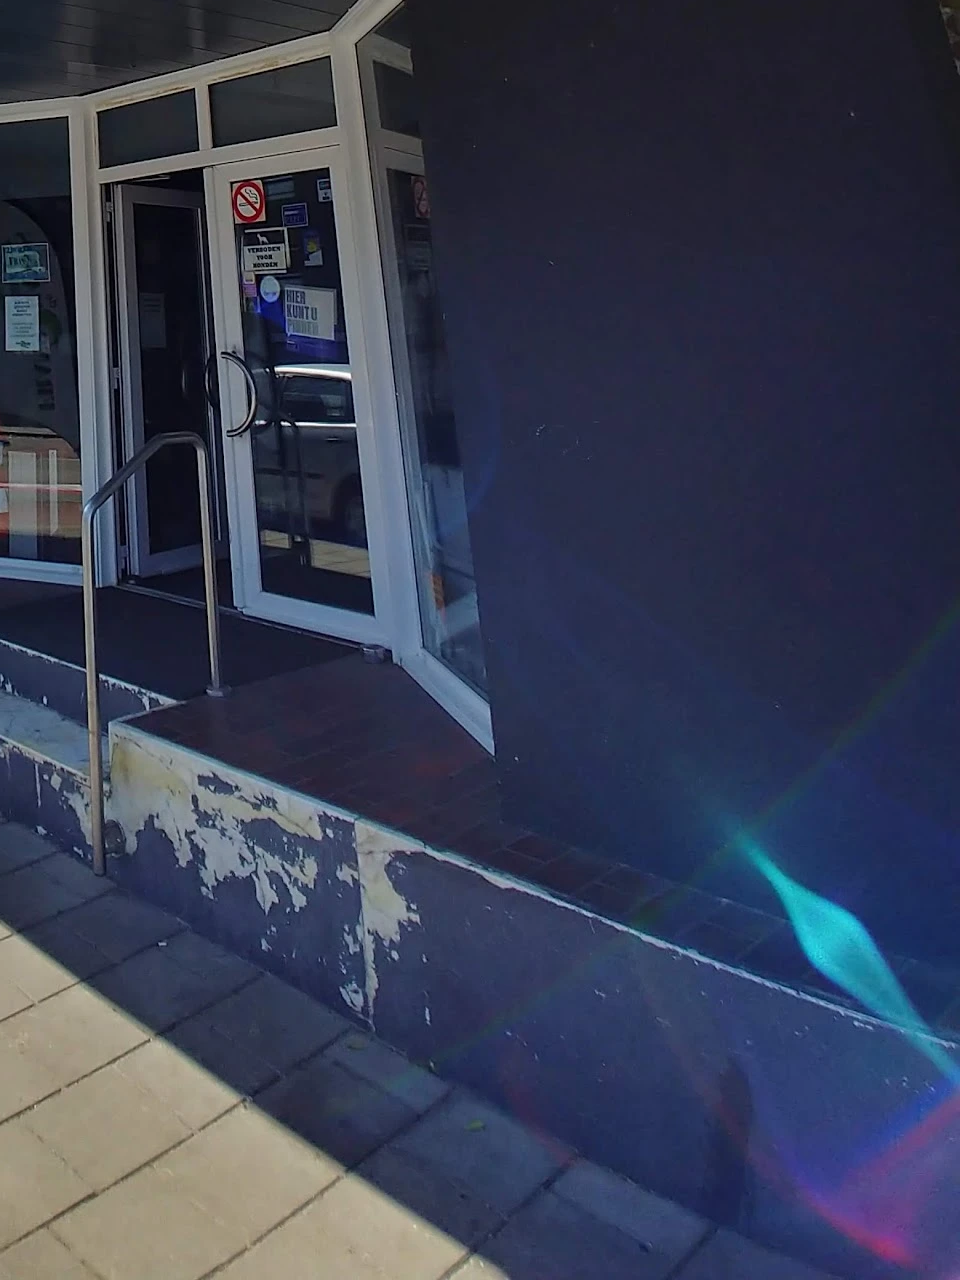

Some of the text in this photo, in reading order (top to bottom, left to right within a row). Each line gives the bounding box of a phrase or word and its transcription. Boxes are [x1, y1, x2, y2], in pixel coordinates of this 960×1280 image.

[286, 289, 306, 304] HIER
[286, 304, 318, 321] KUNT U
